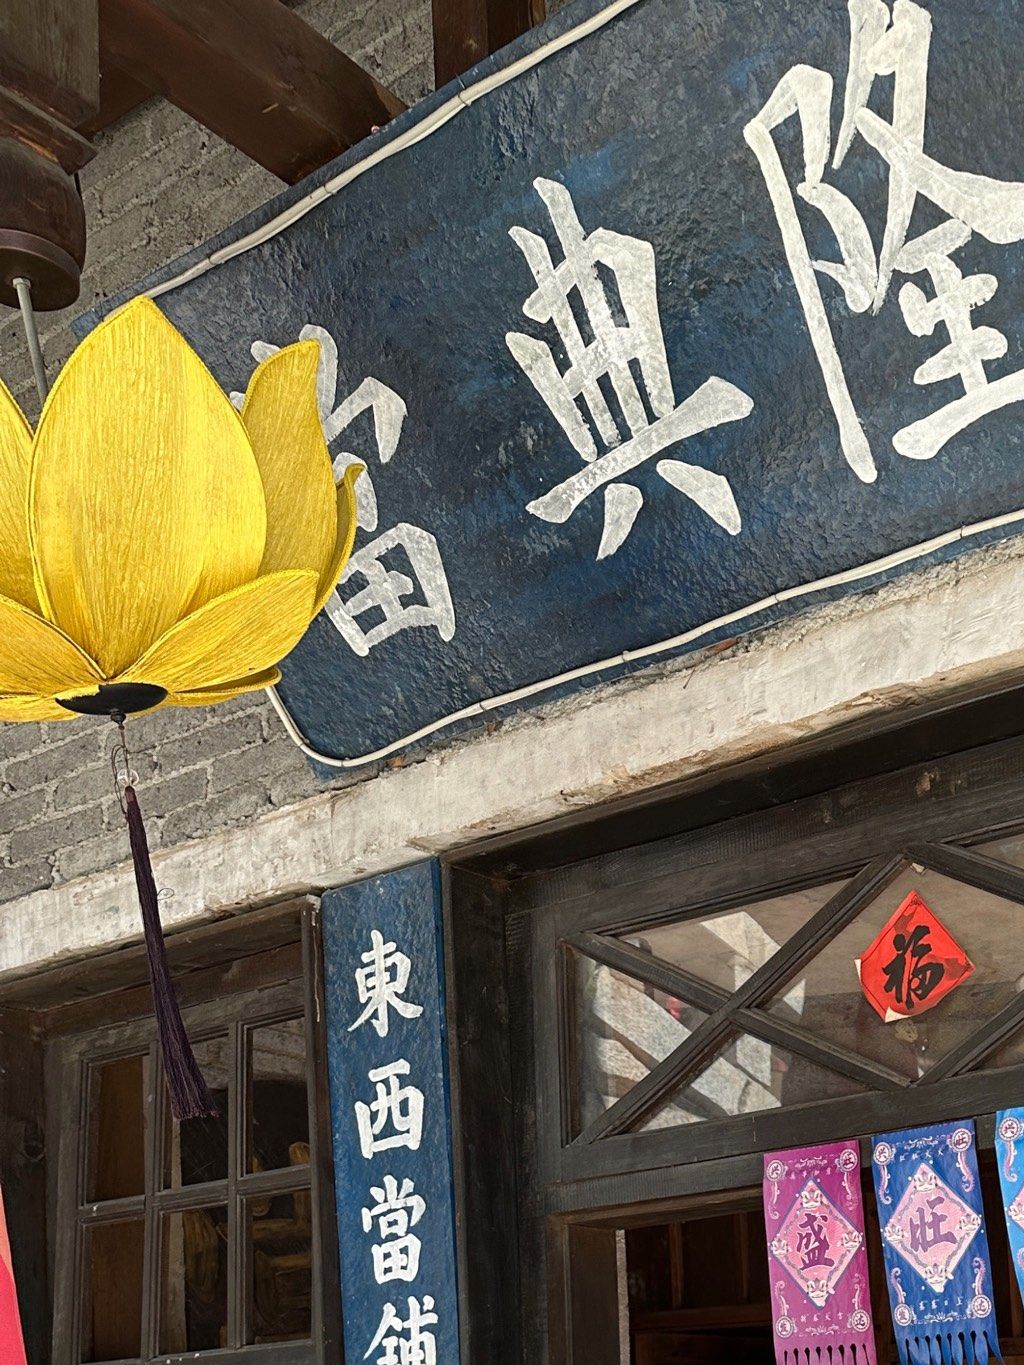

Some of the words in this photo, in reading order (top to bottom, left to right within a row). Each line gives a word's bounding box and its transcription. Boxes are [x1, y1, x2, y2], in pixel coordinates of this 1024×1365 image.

[881, 925, 945, 1010] 福
[796, 1212, 837, 1271] 盛
[908, 1195, 959, 1253] 旺
